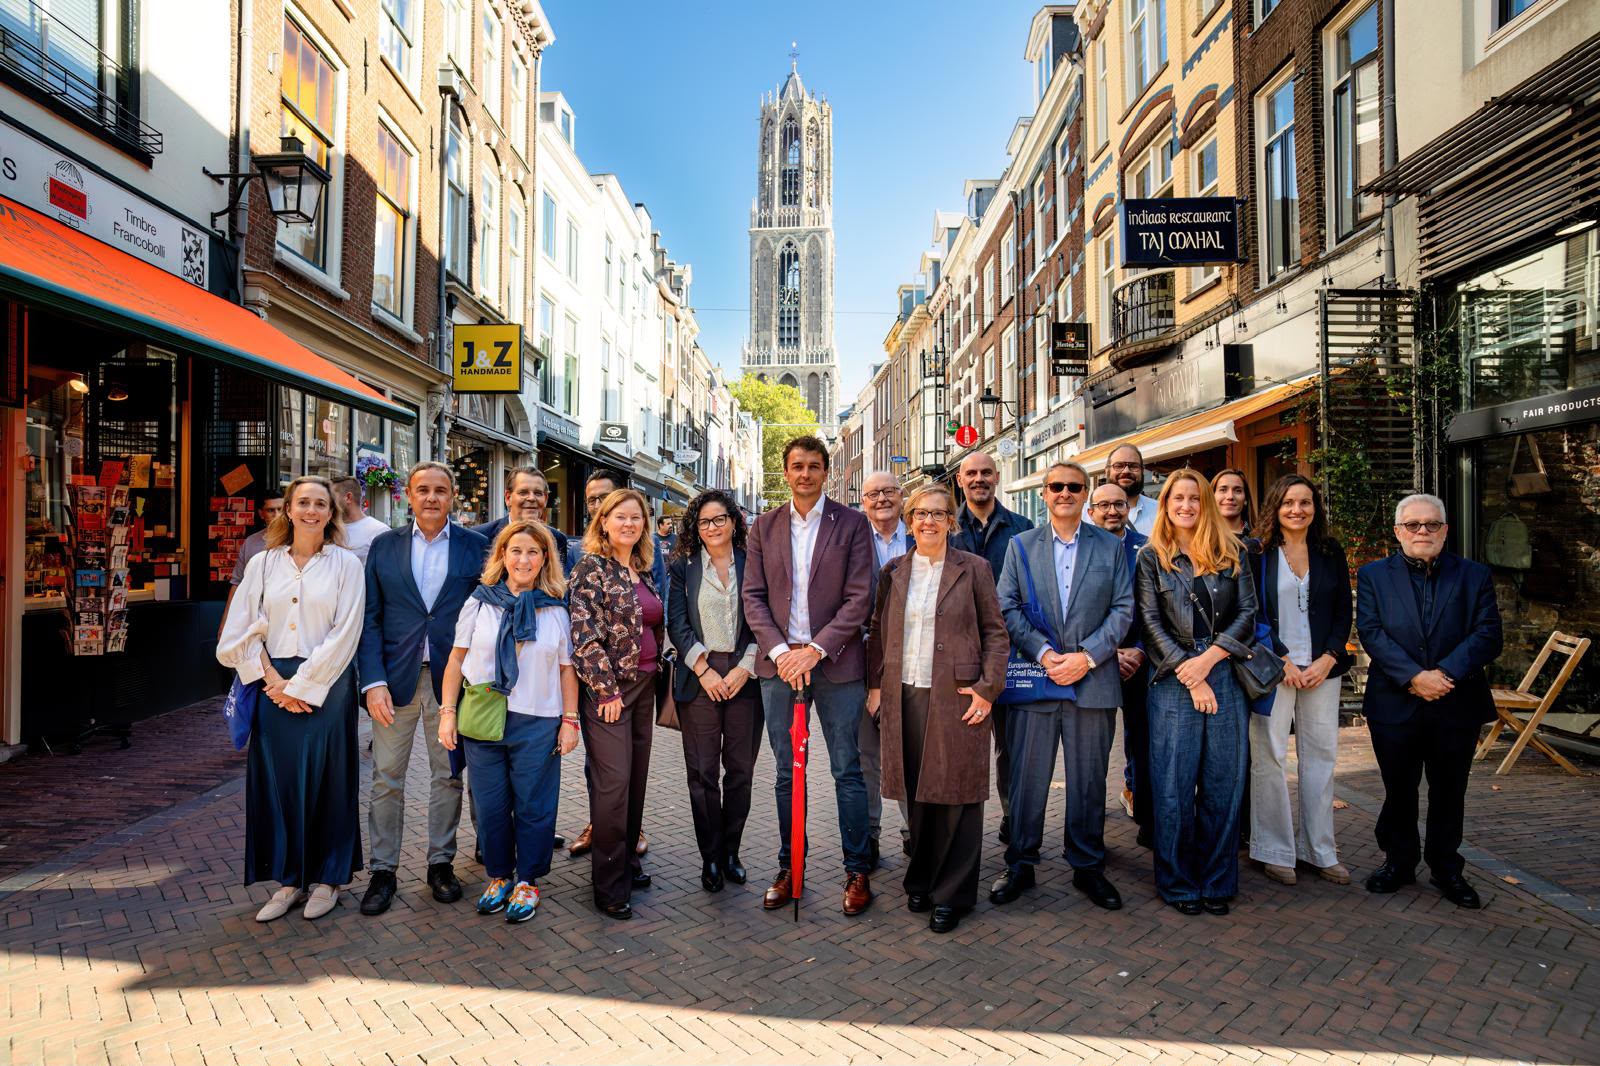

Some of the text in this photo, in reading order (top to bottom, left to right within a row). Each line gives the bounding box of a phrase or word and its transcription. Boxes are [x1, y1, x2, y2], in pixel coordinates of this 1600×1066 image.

[124, 207, 157, 236] Timbre
[113, 221, 166, 258] Francobolli
[1138, 231, 1225, 258] TAJ MAHAL
[461, 341, 513, 368] J&Z
[1055, 366, 1085, 375] Taj Mahal
[1523, 408, 1543, 418] FAIR
[1008, 661, 1031, 669] European
[1013, 669, 1026, 677] Small
[1027, 669, 1043, 677] Retail
